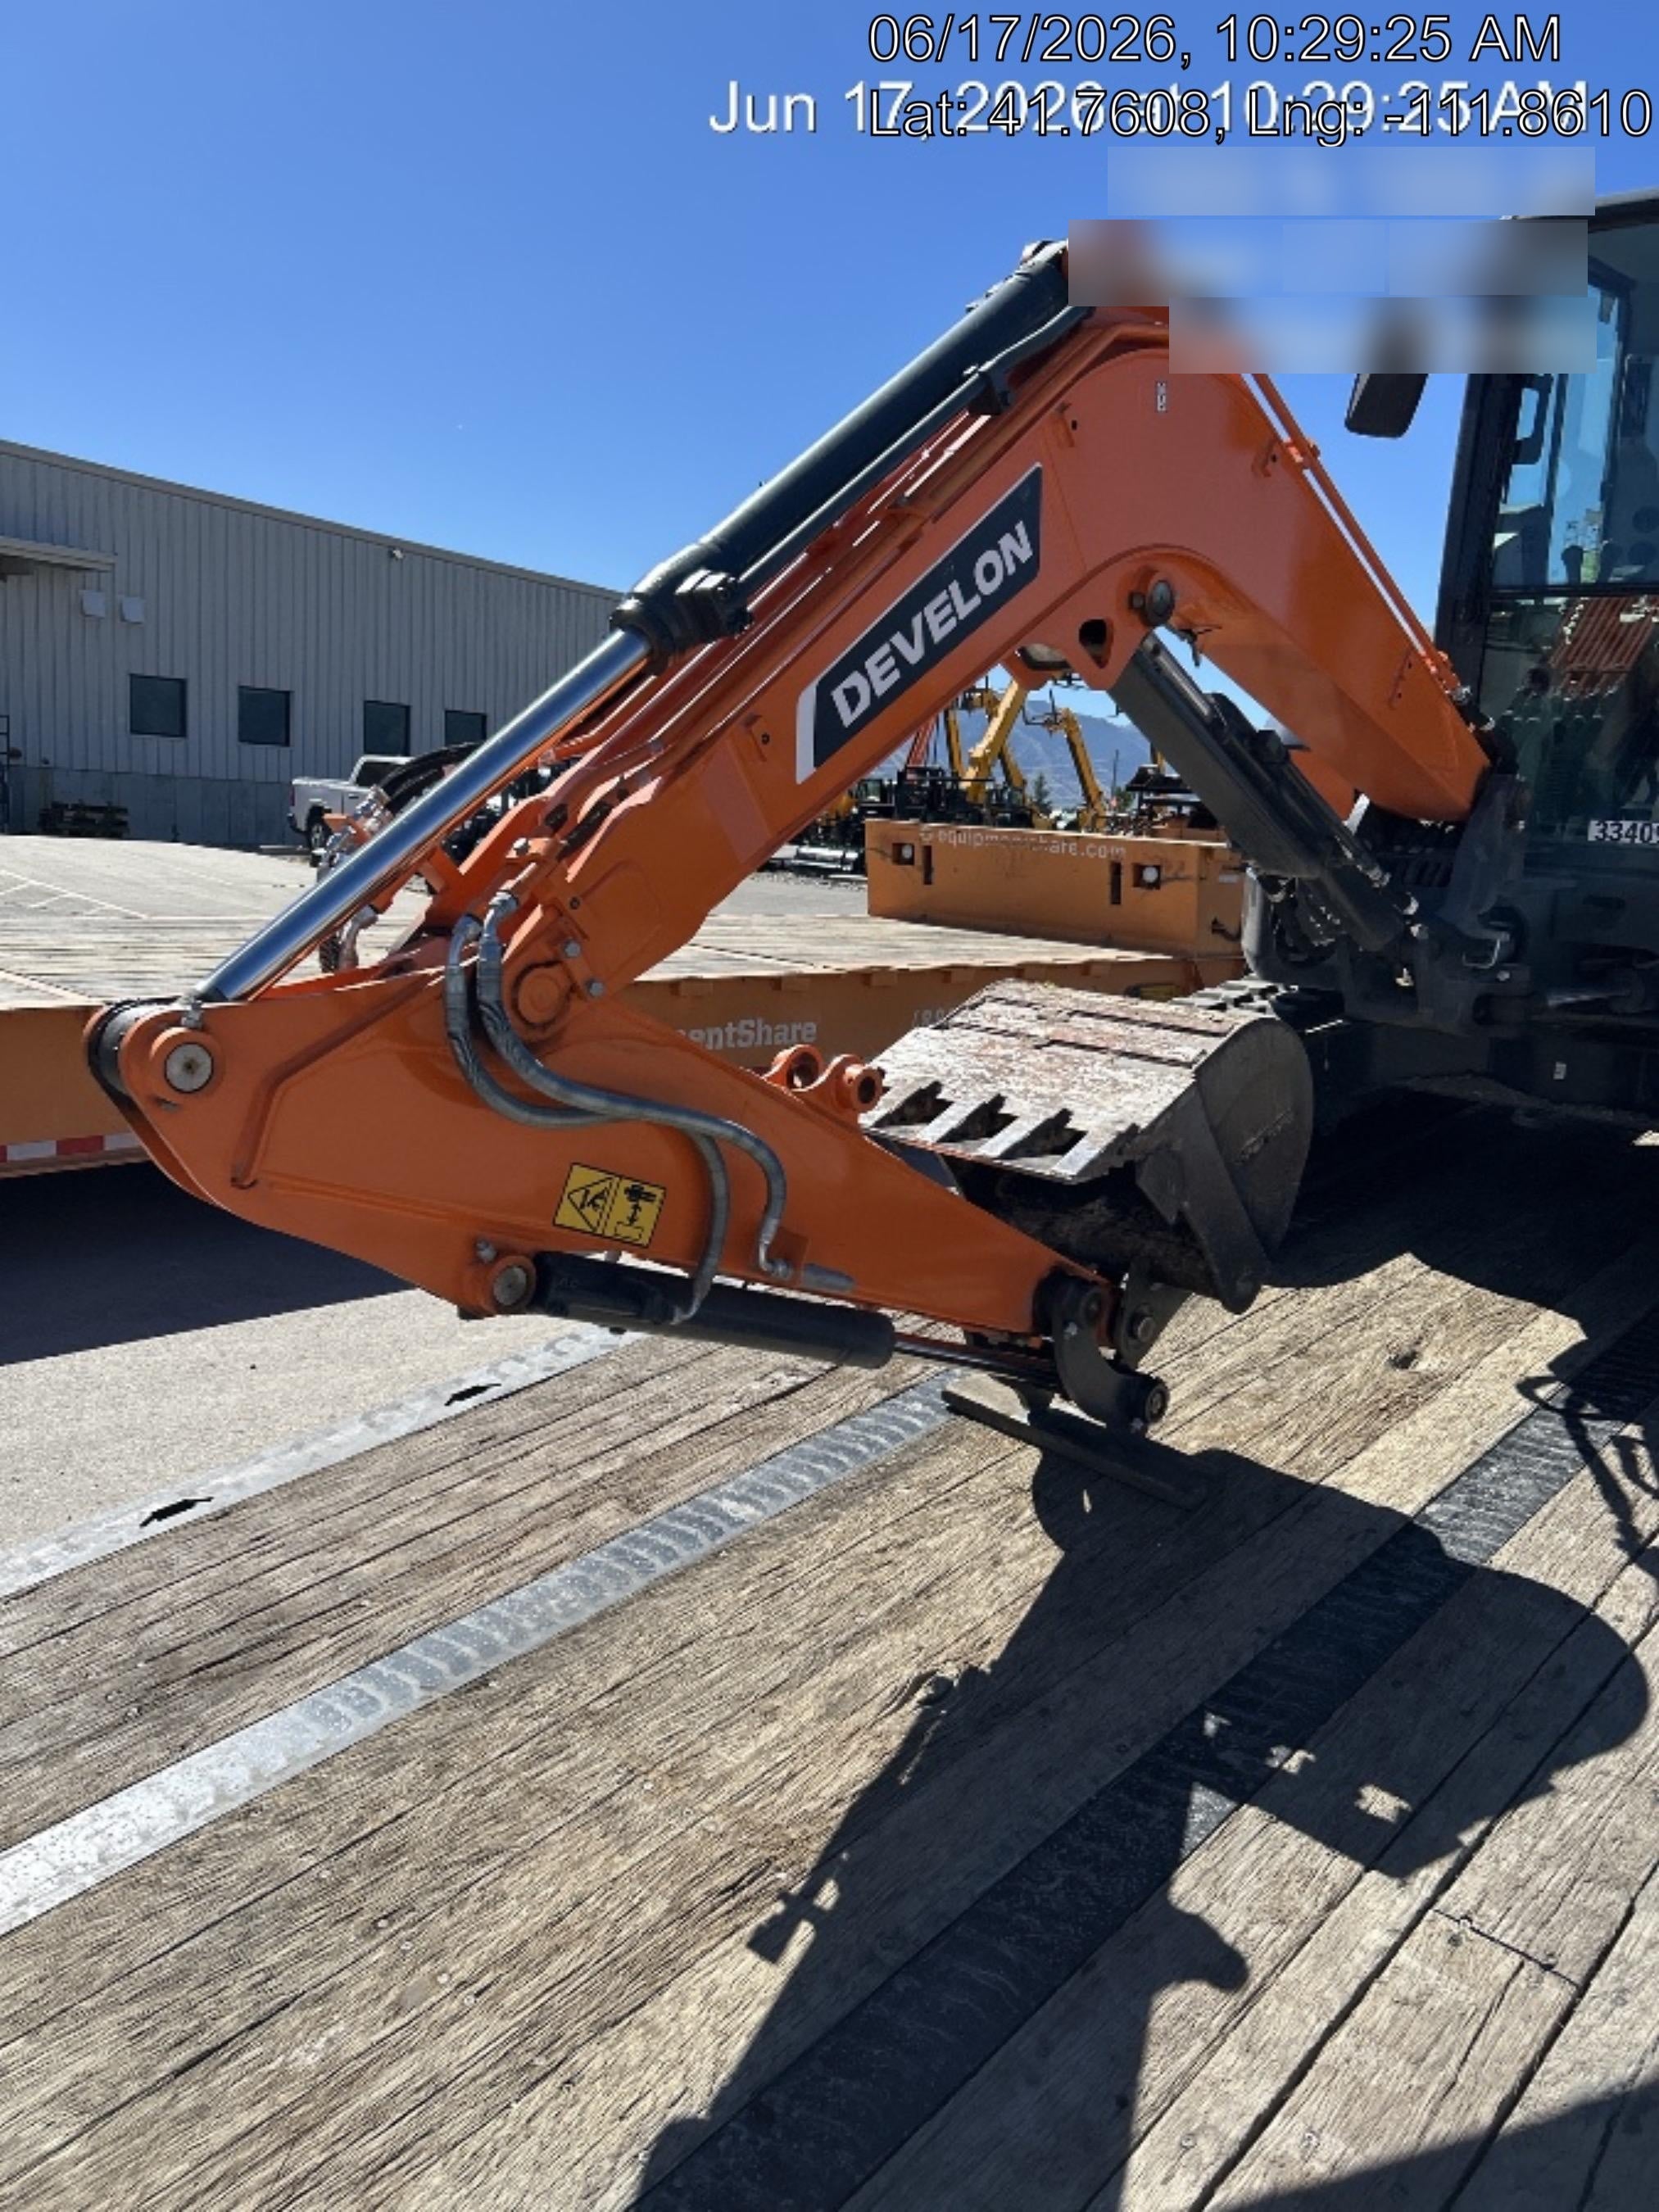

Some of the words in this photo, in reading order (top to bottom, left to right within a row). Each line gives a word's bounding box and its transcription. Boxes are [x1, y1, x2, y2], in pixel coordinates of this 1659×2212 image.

[830, 519, 1034, 729] DEVELON
[938, 828, 1127, 860] equipmhare.com
[1594, 821, 1659, 844] 3340
[680, 1018, 818, 1050] entShare
